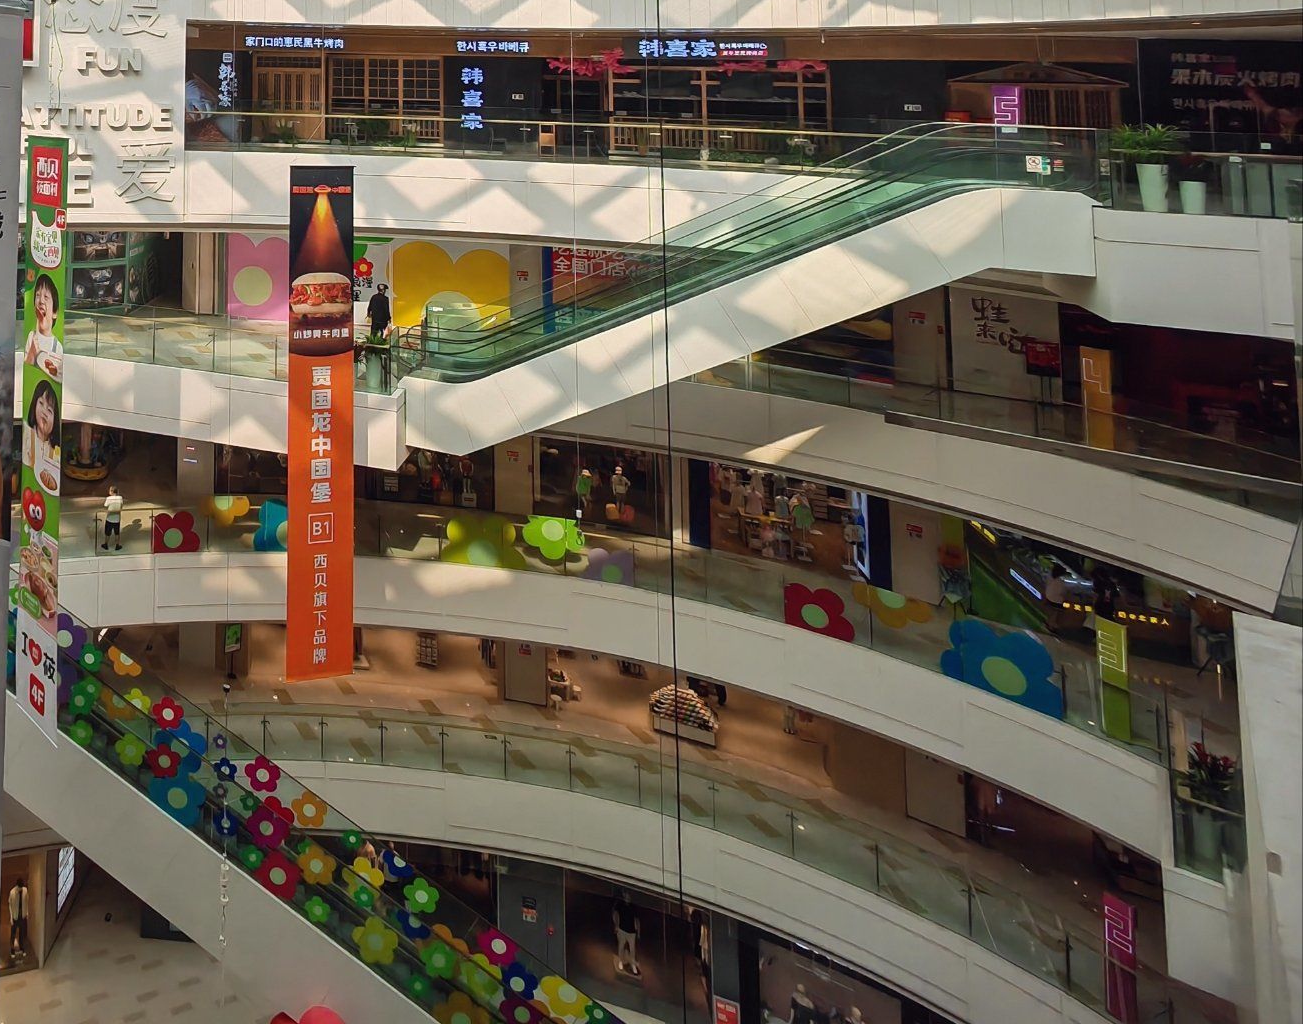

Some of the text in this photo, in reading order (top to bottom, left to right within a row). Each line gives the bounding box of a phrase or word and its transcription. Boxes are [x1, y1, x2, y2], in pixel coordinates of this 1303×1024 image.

[75, 46, 143, 73] FUN
[245, 36, 344, 49] 家门口的惠民黑牛烤肉
[115, 138, 176, 204] 爱
[310, 365, 333, 504] 贾国龙中国堡
[312, 520, 330, 536] B1
[313, 553, 328, 664] 西贝旗下品牌
